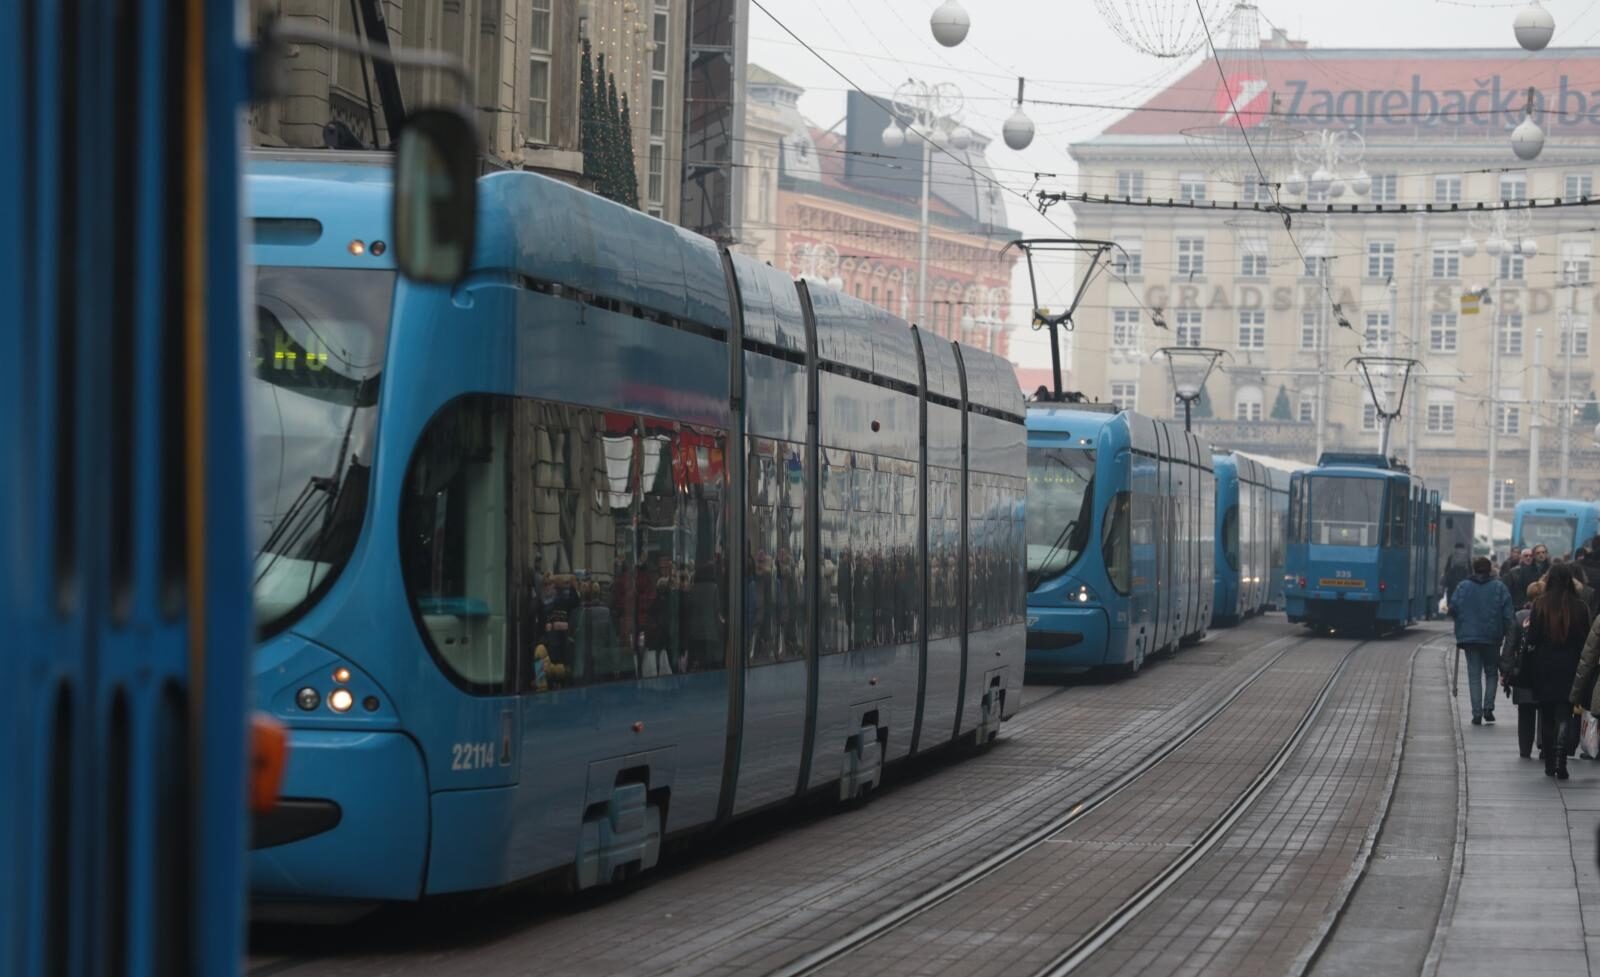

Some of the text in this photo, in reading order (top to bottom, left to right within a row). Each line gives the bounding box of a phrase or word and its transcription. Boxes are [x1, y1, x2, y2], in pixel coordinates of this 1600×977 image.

[1284, 74, 1545, 130] Zagrebačka
[1145, 284, 1359, 312] GRADSKA
[451, 742, 495, 771] 22114
